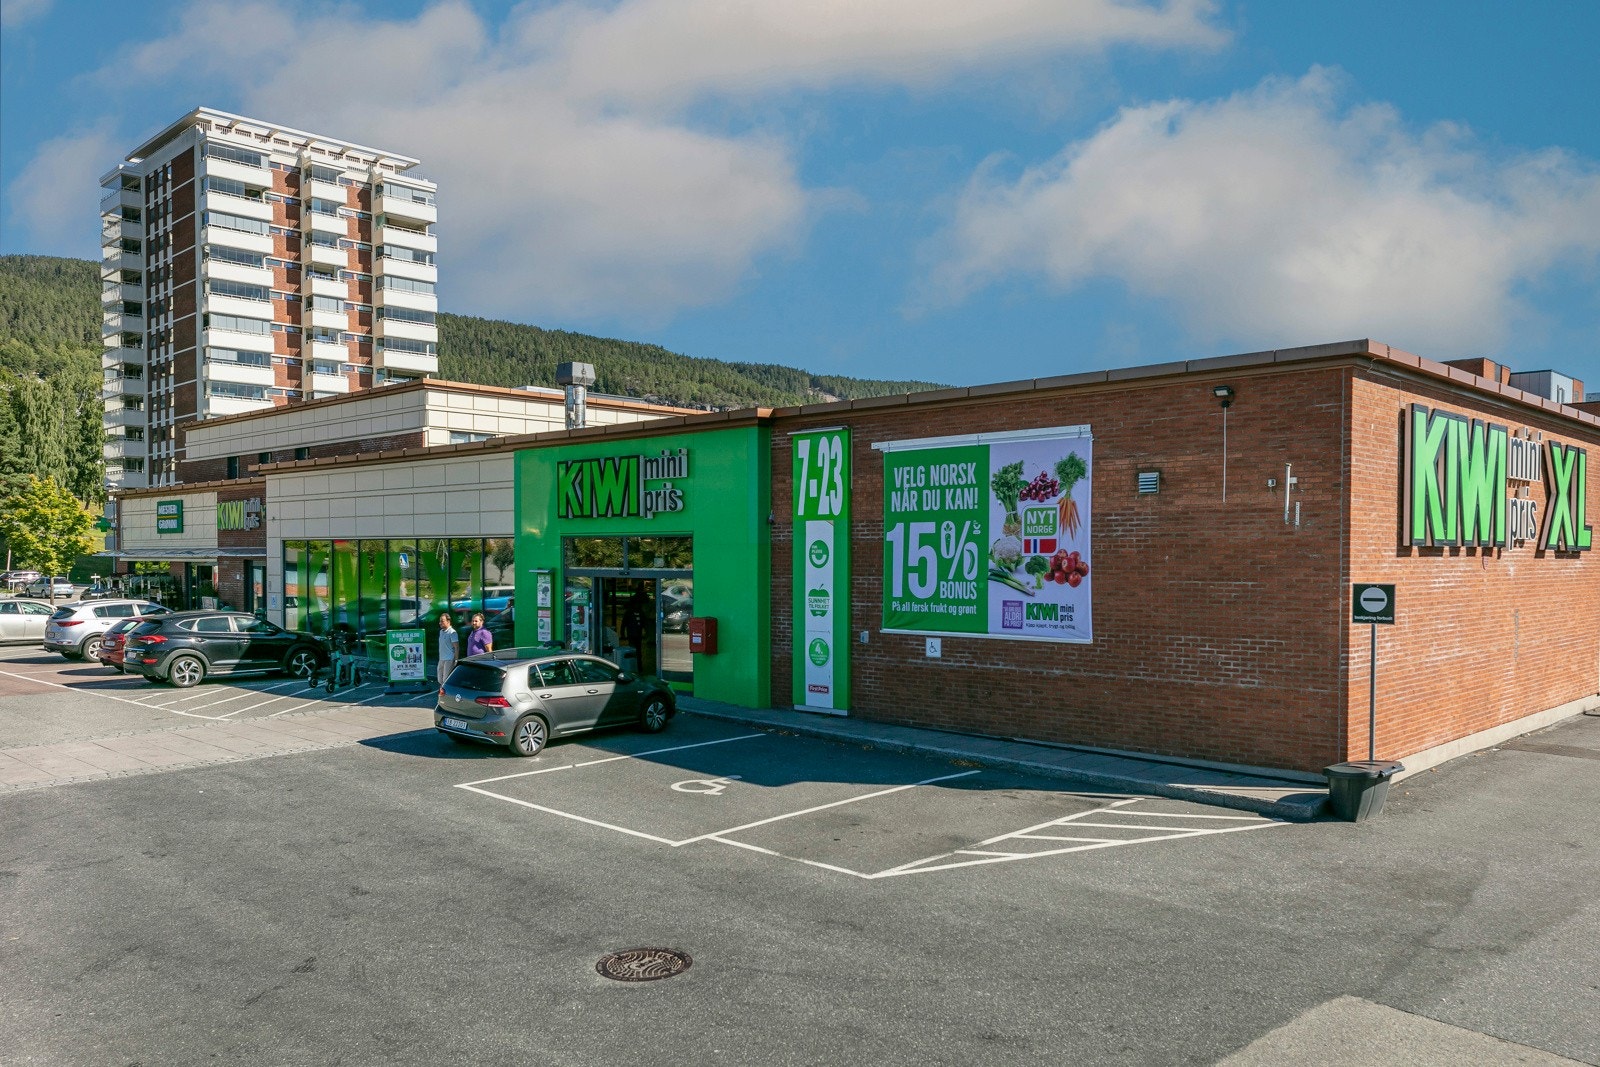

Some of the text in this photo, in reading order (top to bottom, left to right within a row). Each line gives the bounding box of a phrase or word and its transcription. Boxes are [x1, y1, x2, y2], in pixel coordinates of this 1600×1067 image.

[644, 448, 687, 479] mini
[1509, 426, 1542, 482] mini
[557, 455, 640, 518] KIWI
[798, 436, 843, 516] 7-23
[894, 462, 976, 488] VELG NORSK
[1404, 403, 1508, 547] KIWI
[644, 482, 683, 519] pris
[891, 487, 978, 512] NÅR DU KAN!
[1542, 440, 1592, 551] XL
[217, 501, 244, 530] KIWI
[1026, 510, 1056, 525] NYT
[1026, 525, 1053, 534] NORGE
[1509, 486, 1538, 551] pris
[886, 520, 979, 599] 15%
[940, 581, 977, 600] BONUS
[949, 606, 957, 615] og
[1026, 603, 1058, 621] KIWI
[1060, 604, 1075, 613] mini
[1060, 613, 1074, 623] pris
